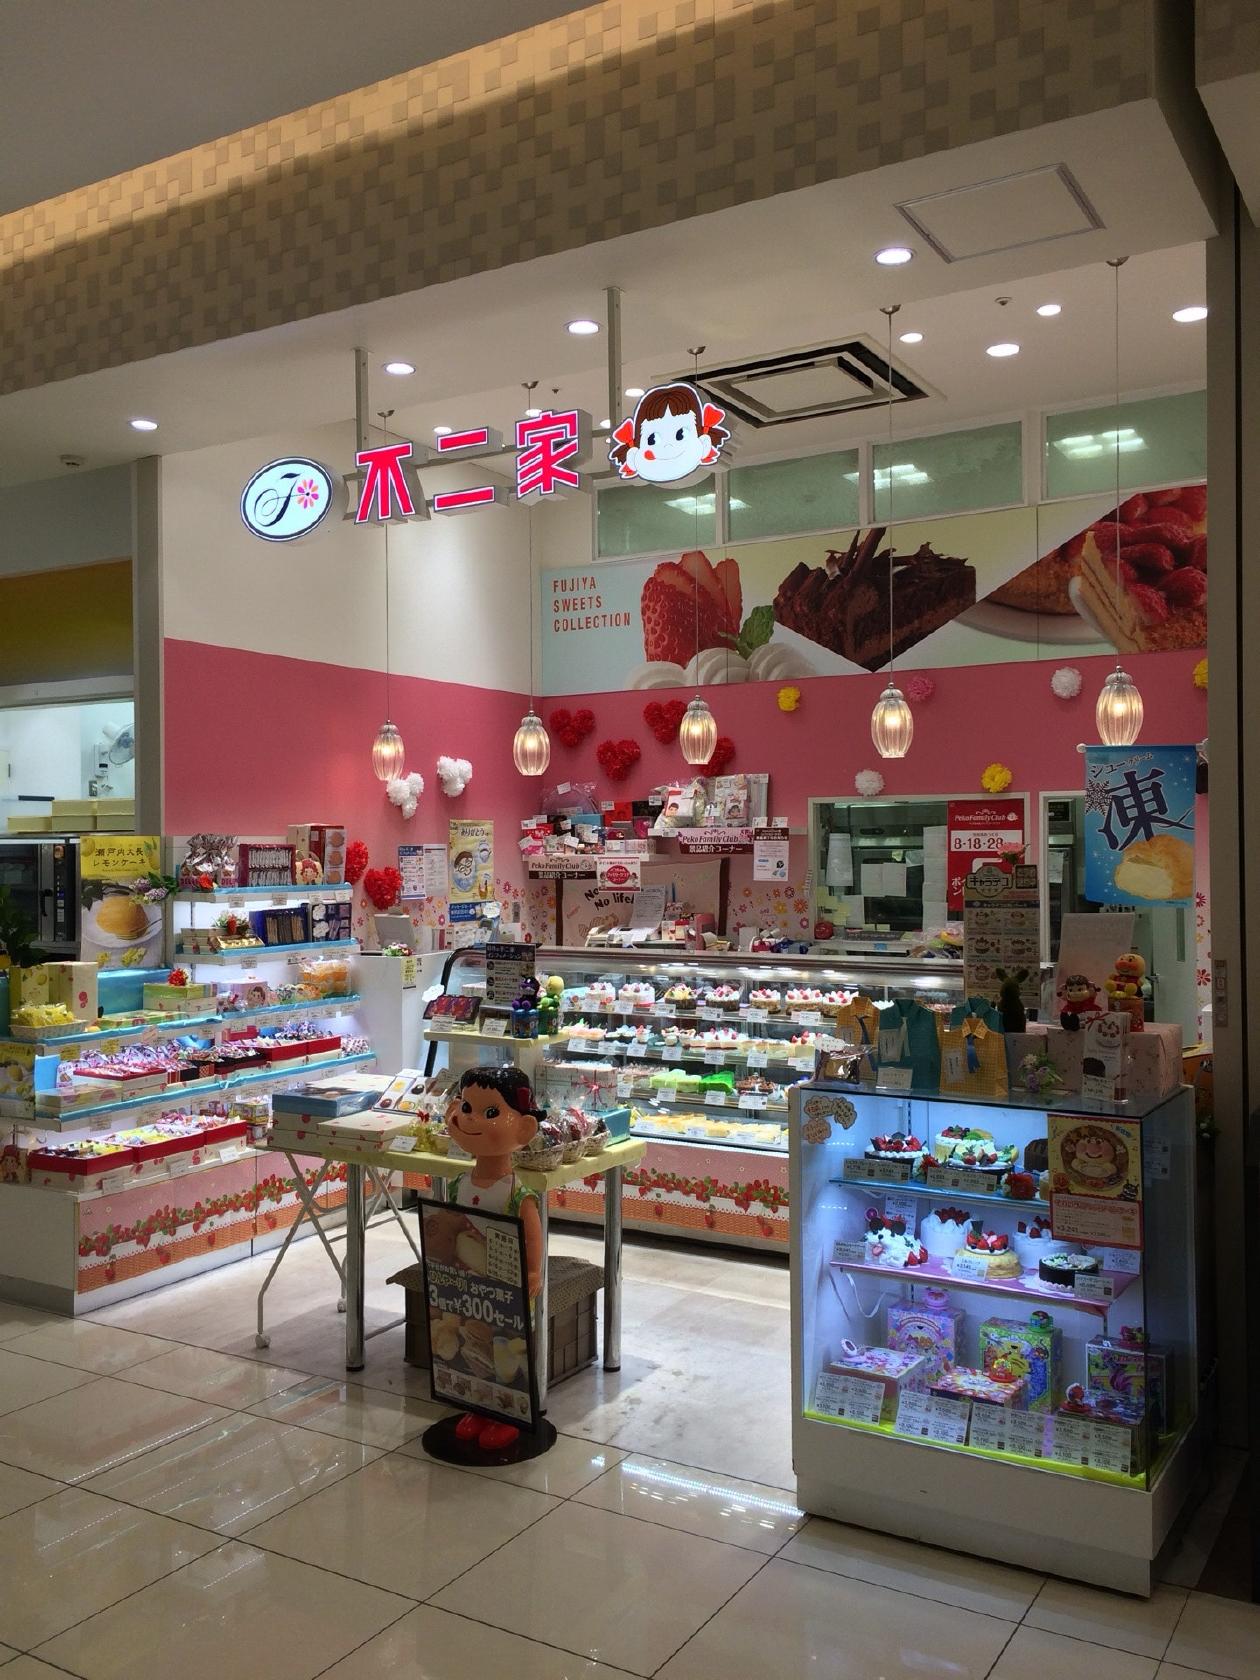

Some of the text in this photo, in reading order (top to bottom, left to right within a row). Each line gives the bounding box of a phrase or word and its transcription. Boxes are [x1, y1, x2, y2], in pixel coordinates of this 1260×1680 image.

[354, 410, 580, 525] 不二家
[553, 576, 597, 593] FUJIYA
[553, 595, 602, 613] SWEETS
[554, 612, 631, 633] COLLECTION
[93, 858, 146, 867] レモンケーキ
[594, 898, 610, 910] No
